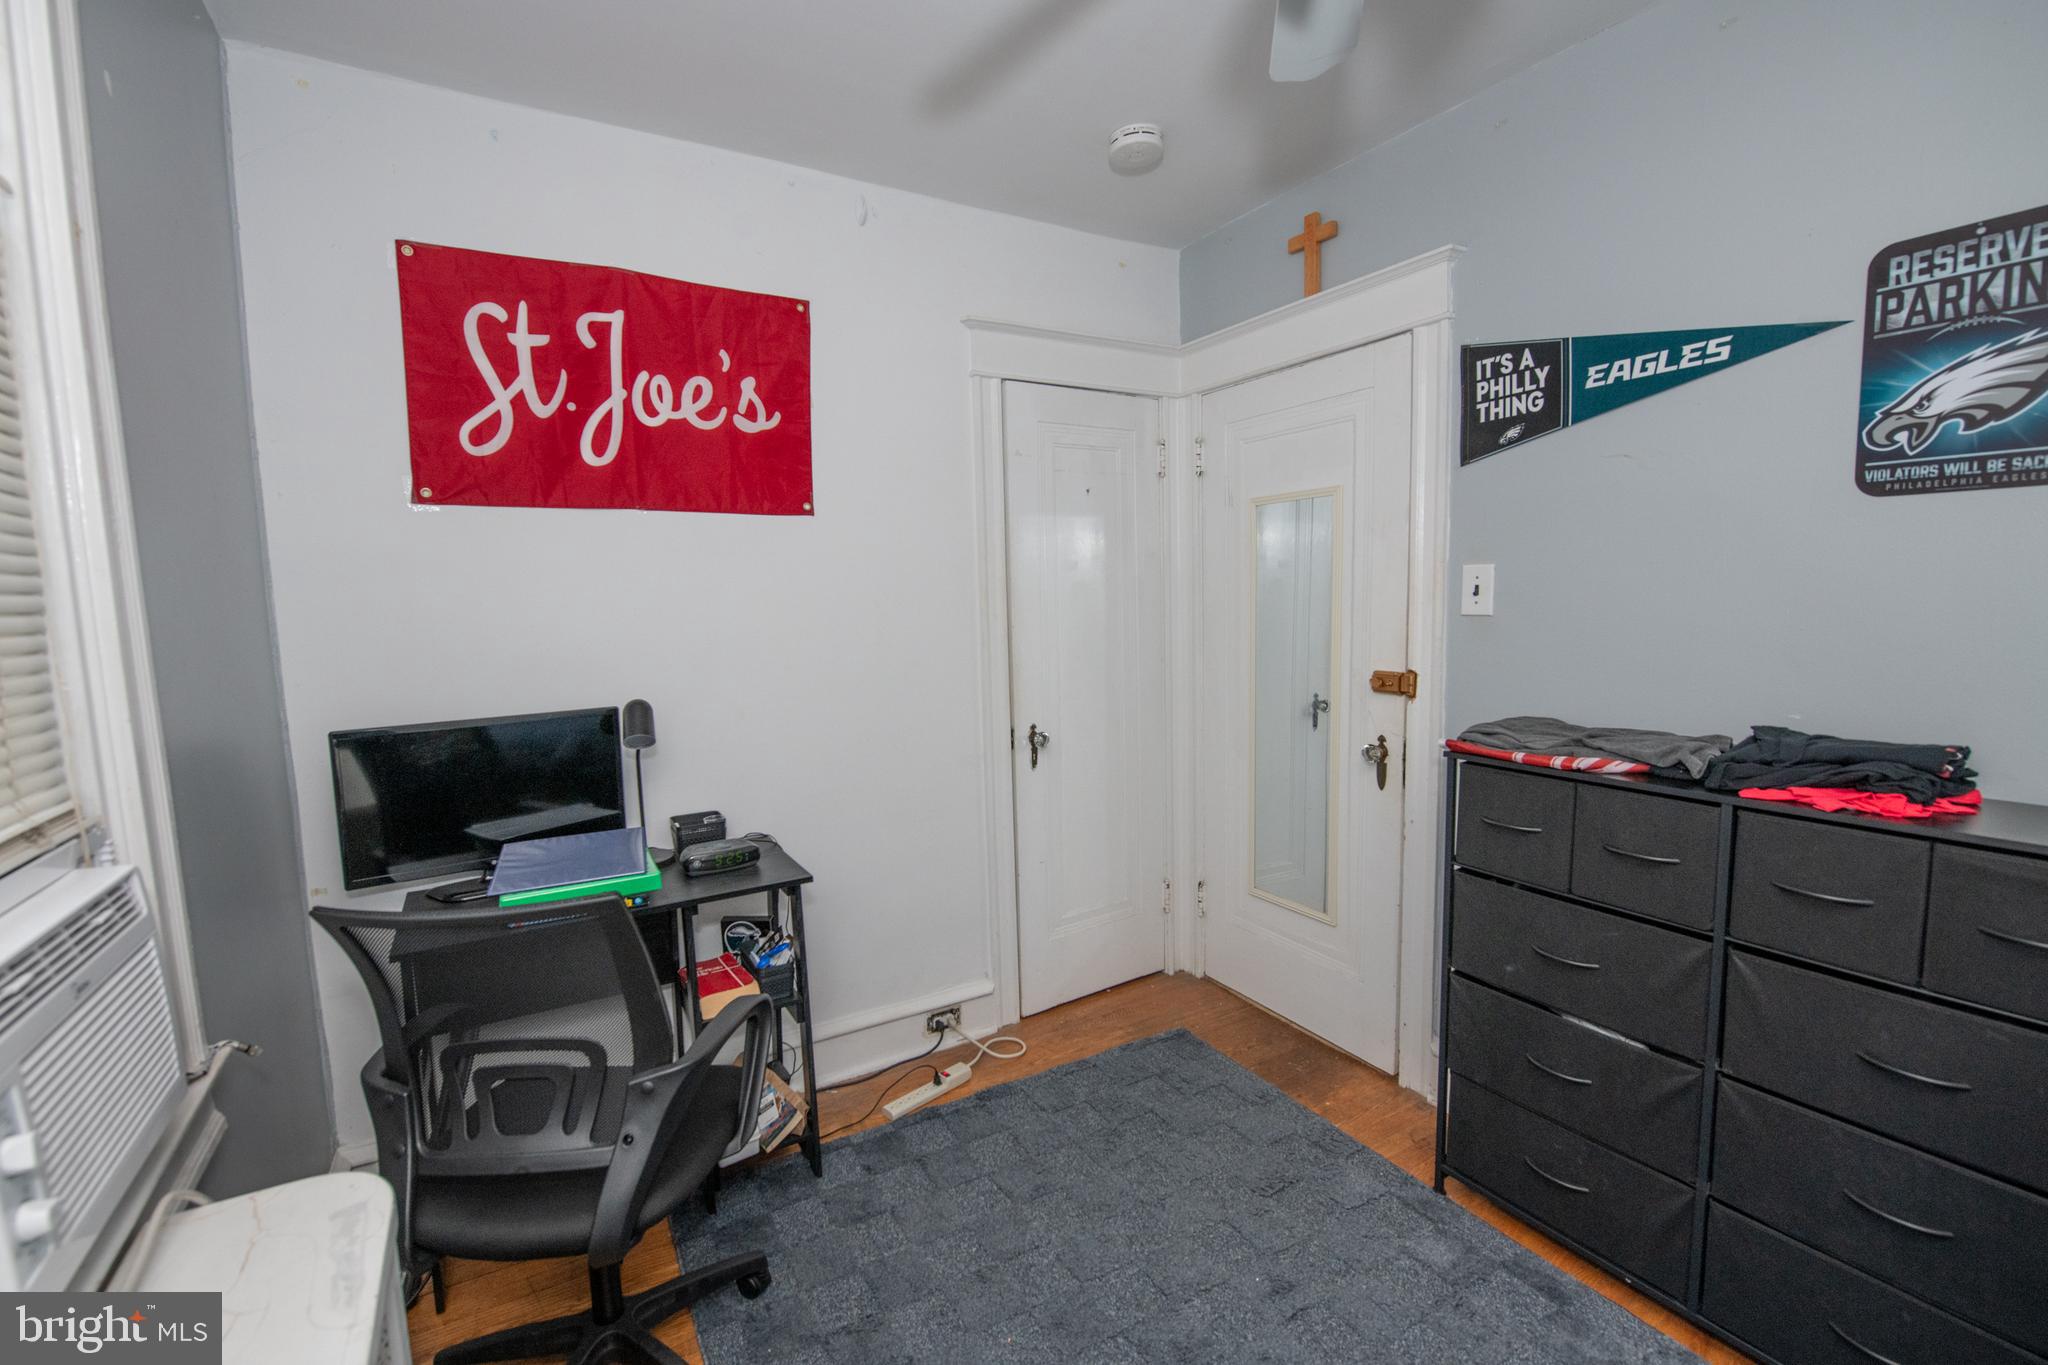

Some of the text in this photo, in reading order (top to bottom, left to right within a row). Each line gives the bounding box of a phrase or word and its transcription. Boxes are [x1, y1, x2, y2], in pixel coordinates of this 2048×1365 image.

[1476, 348, 1535, 381] IT'S A
[1585, 335, 1734, 389] EAGLES
[459, 300, 781, 467] St. Joe's
[1476, 365, 1550, 402] PHILLY
[1476, 391, 1544, 423] THING
[1865, 454, 2048, 482] VIOLATORS WILL BE SAC
[1885, 477, 1983, 491] PHILADELPHIA
[1992, 471, 2048, 483] EAGLES
